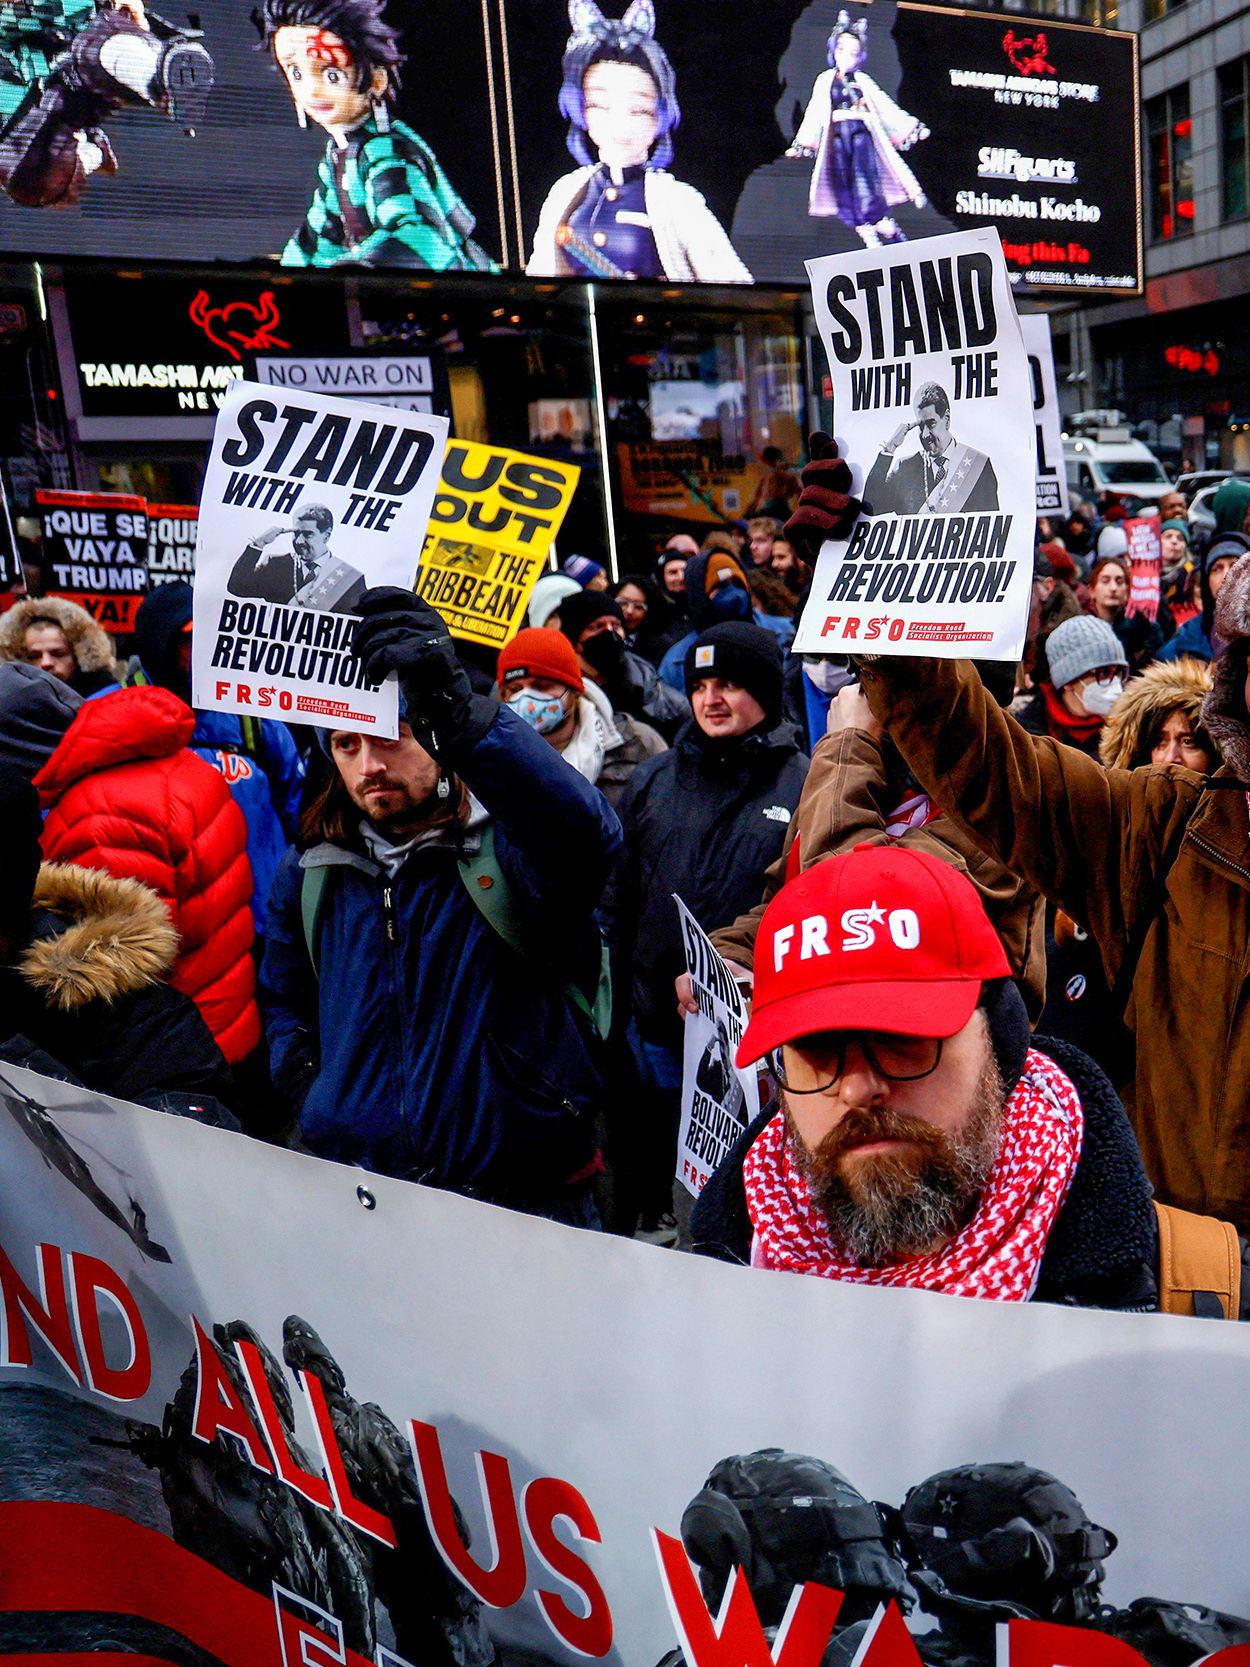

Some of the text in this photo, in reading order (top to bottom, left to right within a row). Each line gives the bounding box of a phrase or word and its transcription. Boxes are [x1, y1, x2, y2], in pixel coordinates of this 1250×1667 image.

[994, 90, 1061, 110] NEW YORK
[955, 190, 1101, 223] Shinobu Kocho
[827, 252, 998, 365] STAND
[268, 365, 307, 386] NO
[315, 365, 377, 386] WAR
[385, 364, 424, 385] ON
[851, 362, 912, 411] WITH
[951, 351, 998, 401] THE
[221, 399, 435, 496] STAND
[441, 447, 566, 510] US
[221, 471, 403, 532] WITH THE
[429, 494, 553, 544] OUT
[44, 510, 147, 539] ¡QUE SE
[843, 515, 1013, 561] BOLIVARIAN
[64, 538, 136, 564] VAYA
[493, 552, 536, 587] THE
[53, 564, 147, 591] TRUMP
[827, 561, 1016, 603] REVOLUTION!
[218, 599, 364, 653] BOLIVARIA
[820, 614, 964, 642] FRSO Freedom Road
[908, 631, 993, 642] Socialist Organization
[216, 681, 293, 711] FRSO
[298, 696, 328, 708] Freedom
[298, 703, 376, 723] Socialist Organization
[773, 900, 921, 974] FRSO
[684, 915, 743, 1018] STAND
[191, 1312, 399, 1550] ALL
[405, 1418, 613, 1658] US
